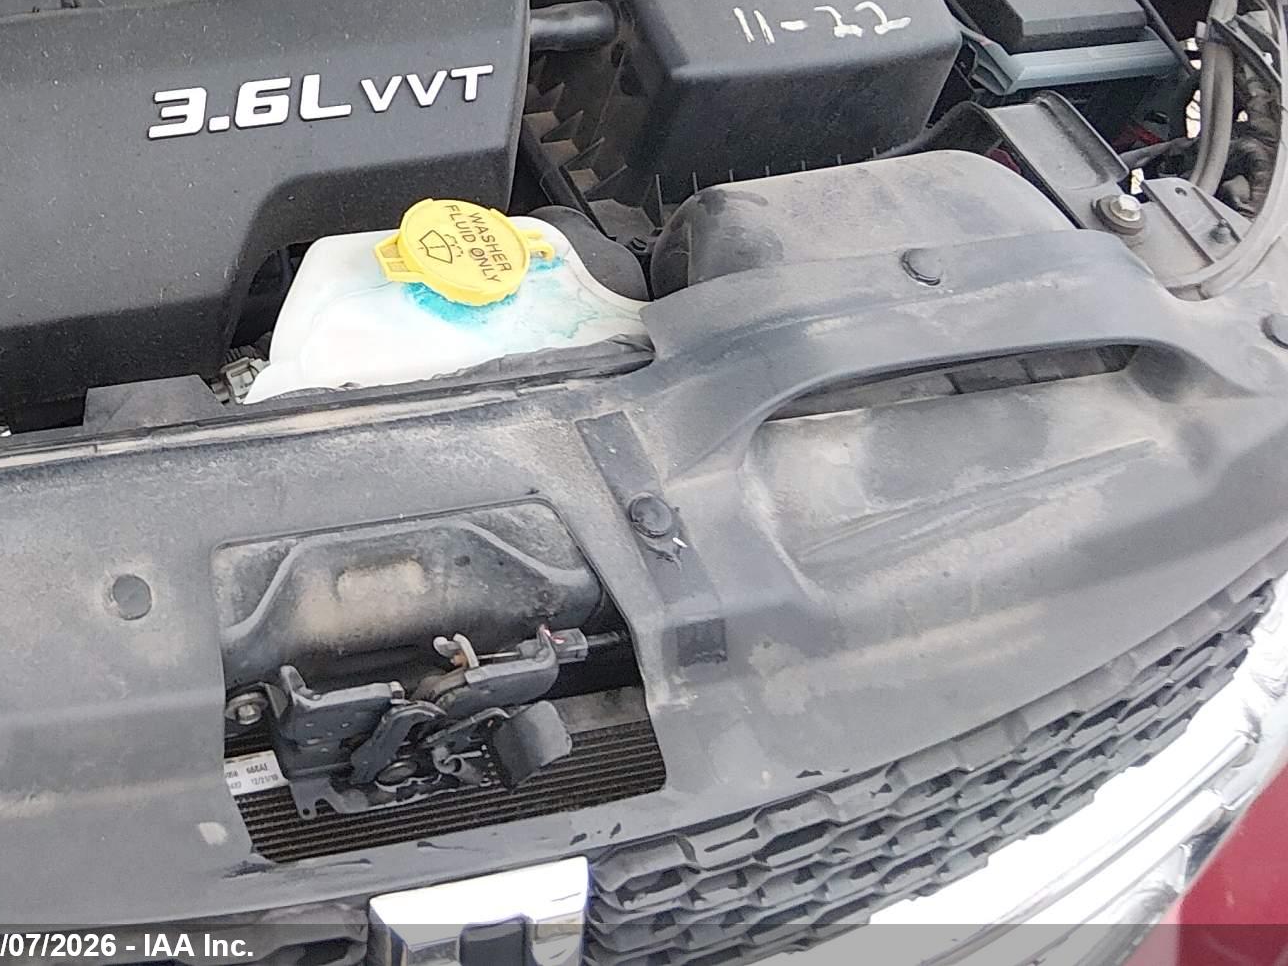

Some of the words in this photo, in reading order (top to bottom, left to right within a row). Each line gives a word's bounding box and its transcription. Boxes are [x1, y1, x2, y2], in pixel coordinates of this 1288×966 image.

[733, 1, 911, 44] 11-22
[147, 73, 352, 139] 3.6L
[360, 64, 494, 112] VVT
[444, 204, 476, 243] FLUID
[470, 247, 501, 283] ONLY
[468, 212, 512, 272] WASHER
